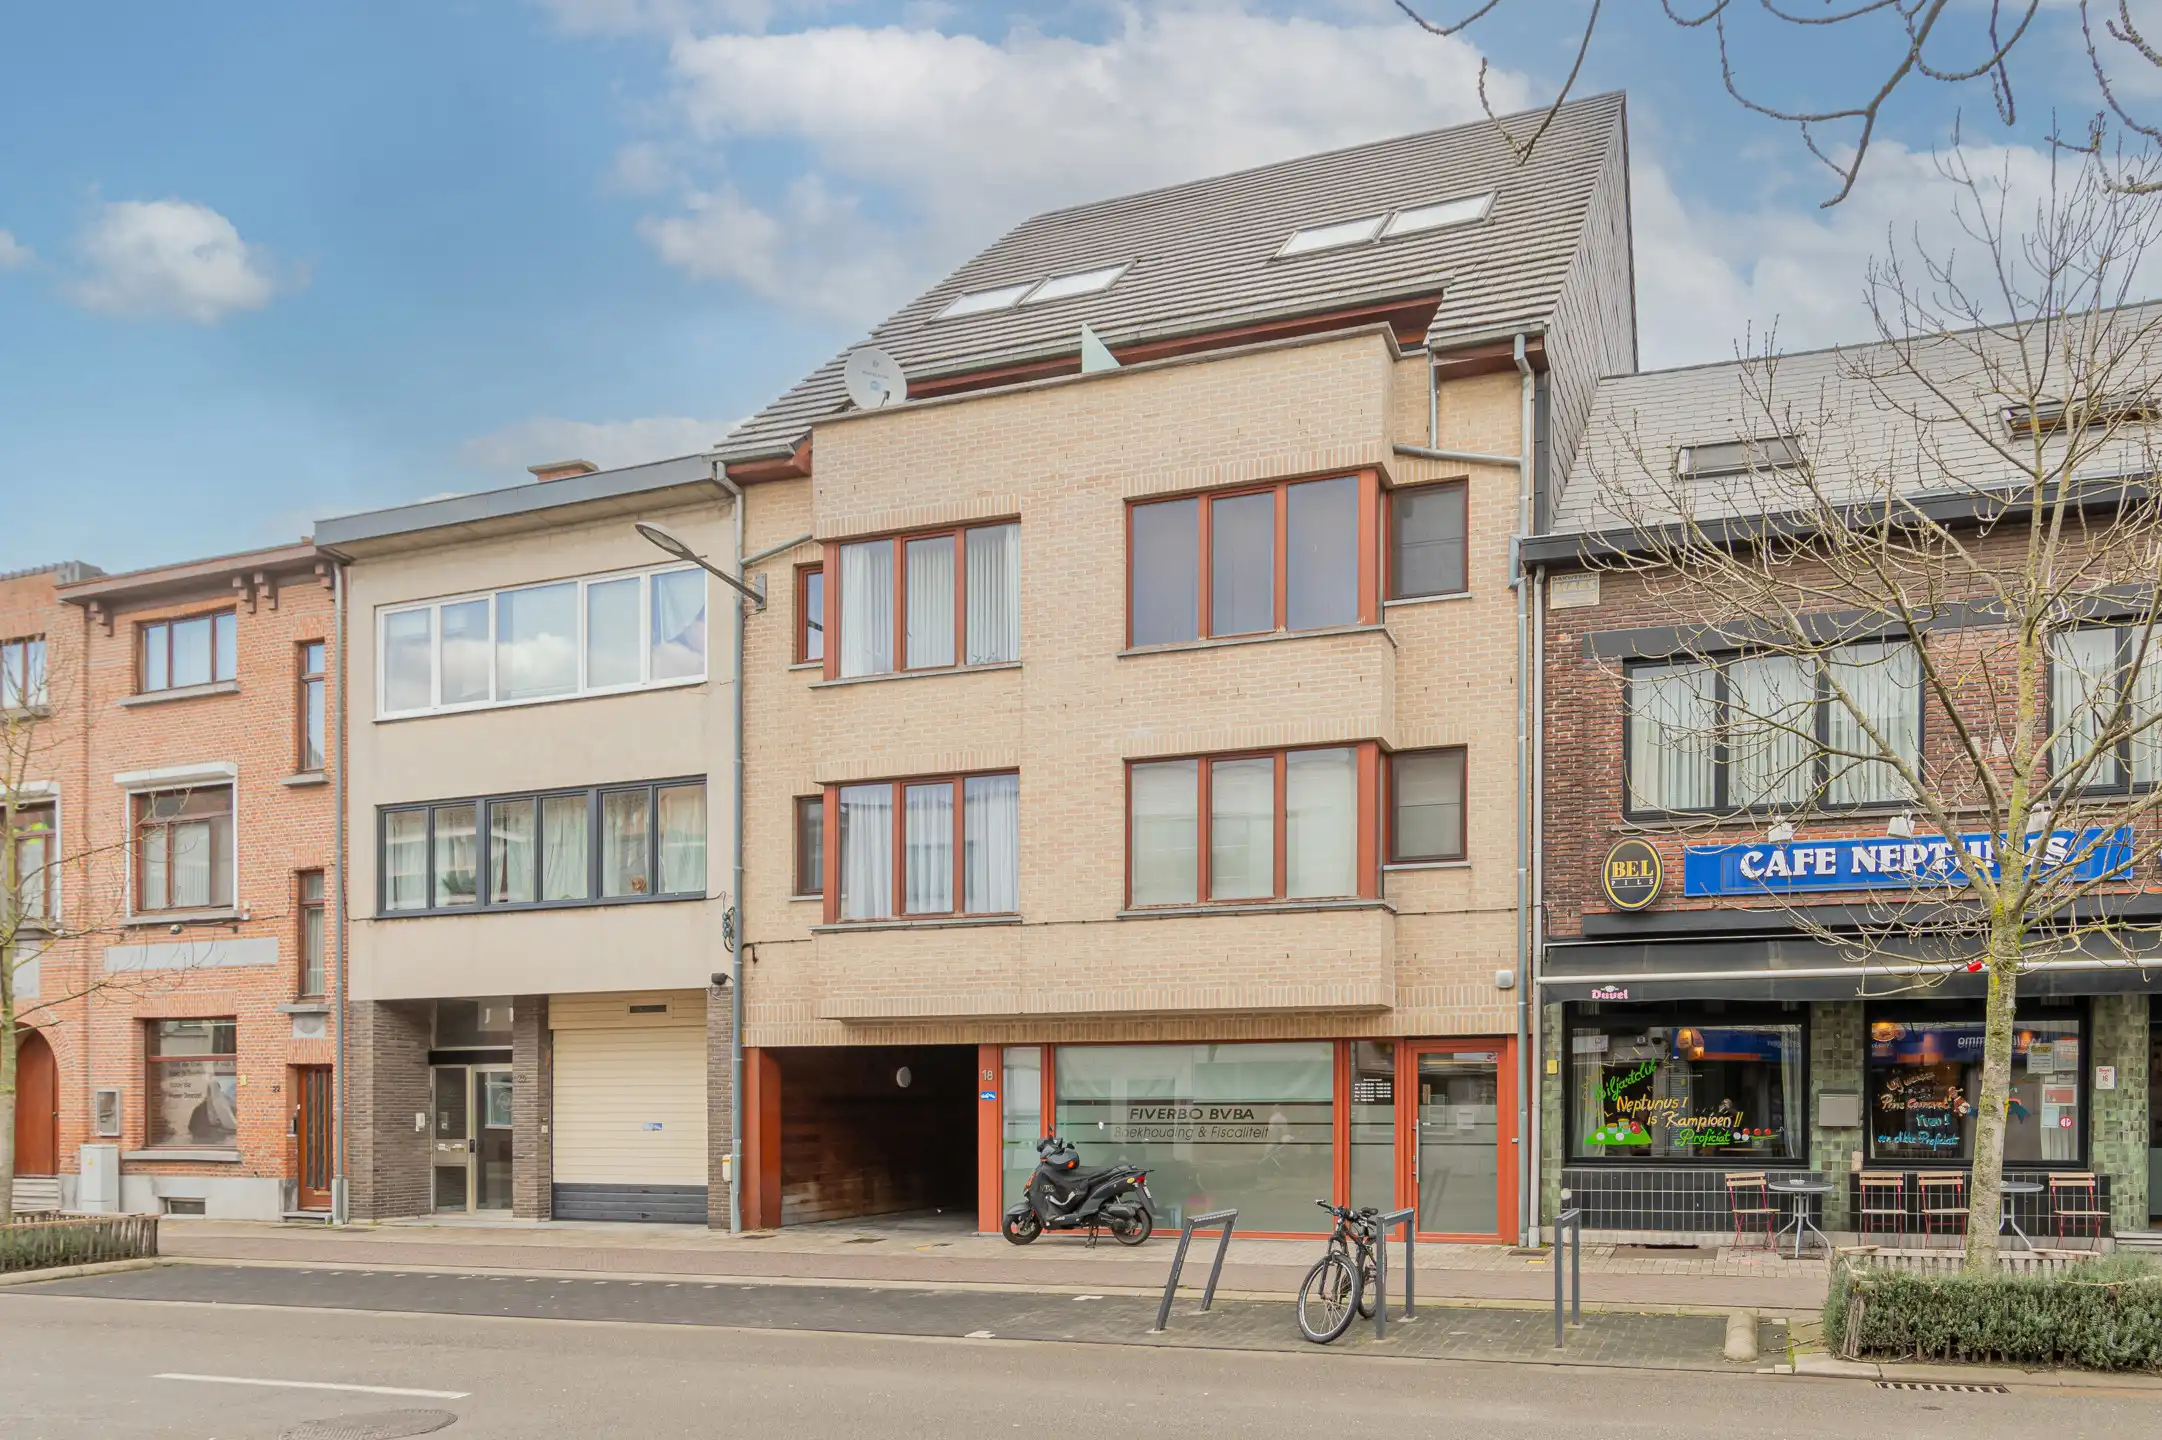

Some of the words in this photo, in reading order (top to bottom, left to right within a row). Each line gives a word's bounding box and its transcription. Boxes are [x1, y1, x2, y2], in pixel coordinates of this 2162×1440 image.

[1612, 860, 1654, 877] BEL
[1740, 847, 1837, 878] CAFE
[1591, 988, 1629, 1000] Duvel
[982, 1069, 994, 1081] 18
[1594, 1057, 1657, 1101] Biljartclub
[1616, 1094, 1679, 1118] Neptunus
[1130, 1108, 1204, 1120] FIVERBO
[1209, 1108, 1255, 1120] BVBA
[1647, 1112, 1658, 1125] is
[1198, 1126, 1207, 1138] &
[1211, 1126, 1270, 1138] Fiscaliteit
[1676, 1128, 1732, 1148] Proficiat
